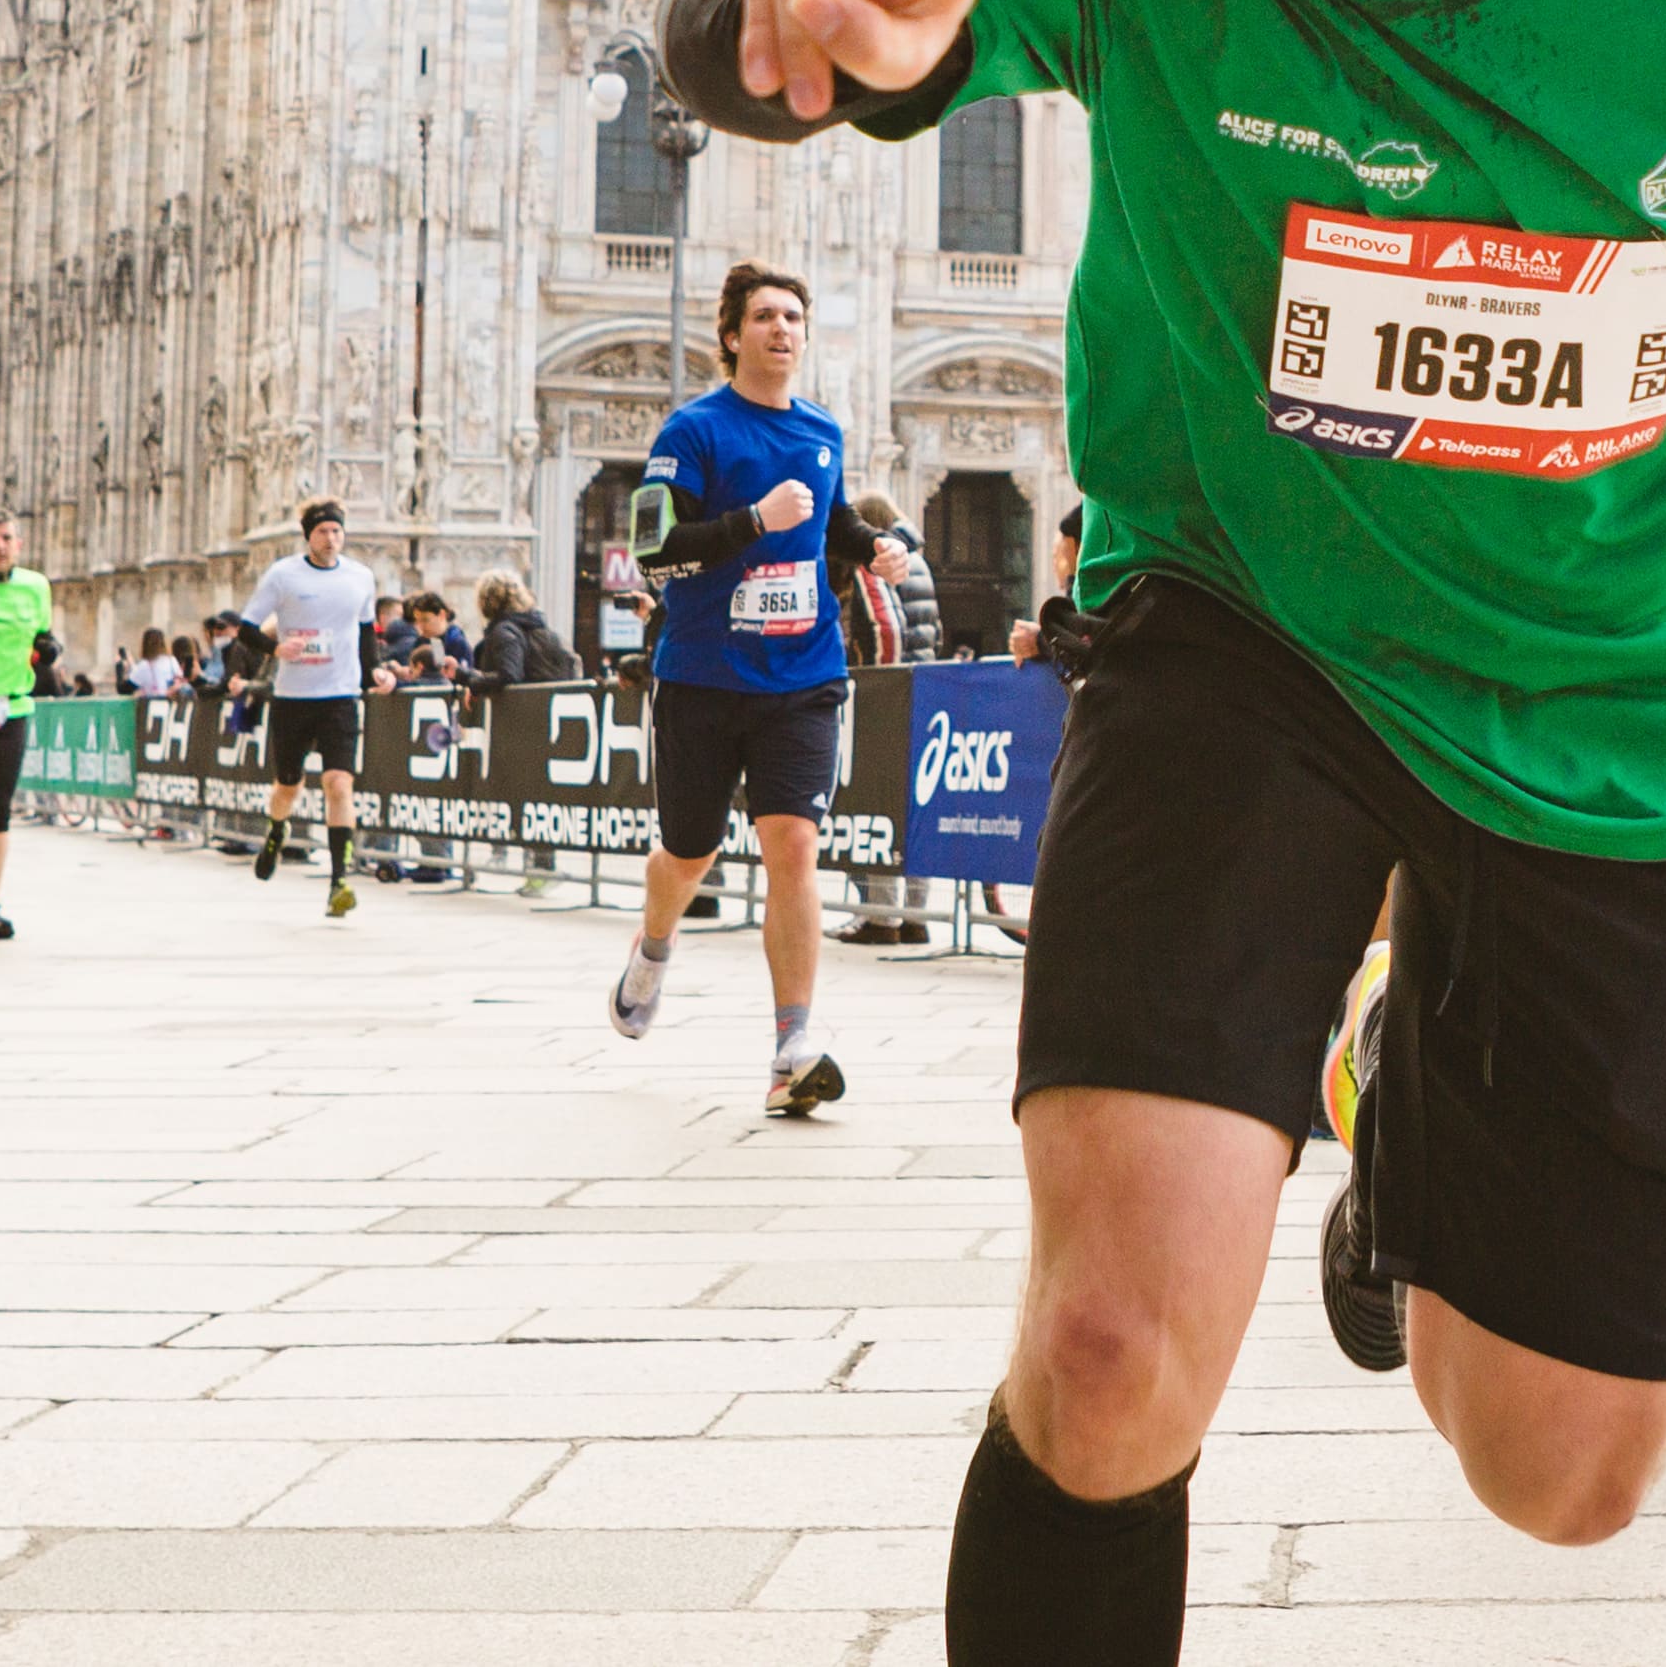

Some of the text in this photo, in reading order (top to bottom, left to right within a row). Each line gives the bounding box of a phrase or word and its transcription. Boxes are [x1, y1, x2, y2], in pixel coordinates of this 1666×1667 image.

[1218, 110, 1276, 137] ALICE
[1281, 126, 1321, 147] FOR
[1316, 227, 1401, 255] Lenovo
[1482, 240, 1563, 264] RELAY
[1480, 253, 1562, 276] MARATHON
[1425, 292, 1468, 310] DLYNR
[1479, 297, 1542, 317] BRAVERS
[1374, 322, 1583, 409] 1633A
[1437, 437, 1522, 459] Telepass
[1586, 426, 1658, 453] MILANO
[607, 552, 643, 583] M
[759, 592, 799, 613] 365A
[389, 793, 512, 841] DRONE HOPPER
[521, 802, 589, 846] DRONE
[816, 814, 894, 866] PPER
